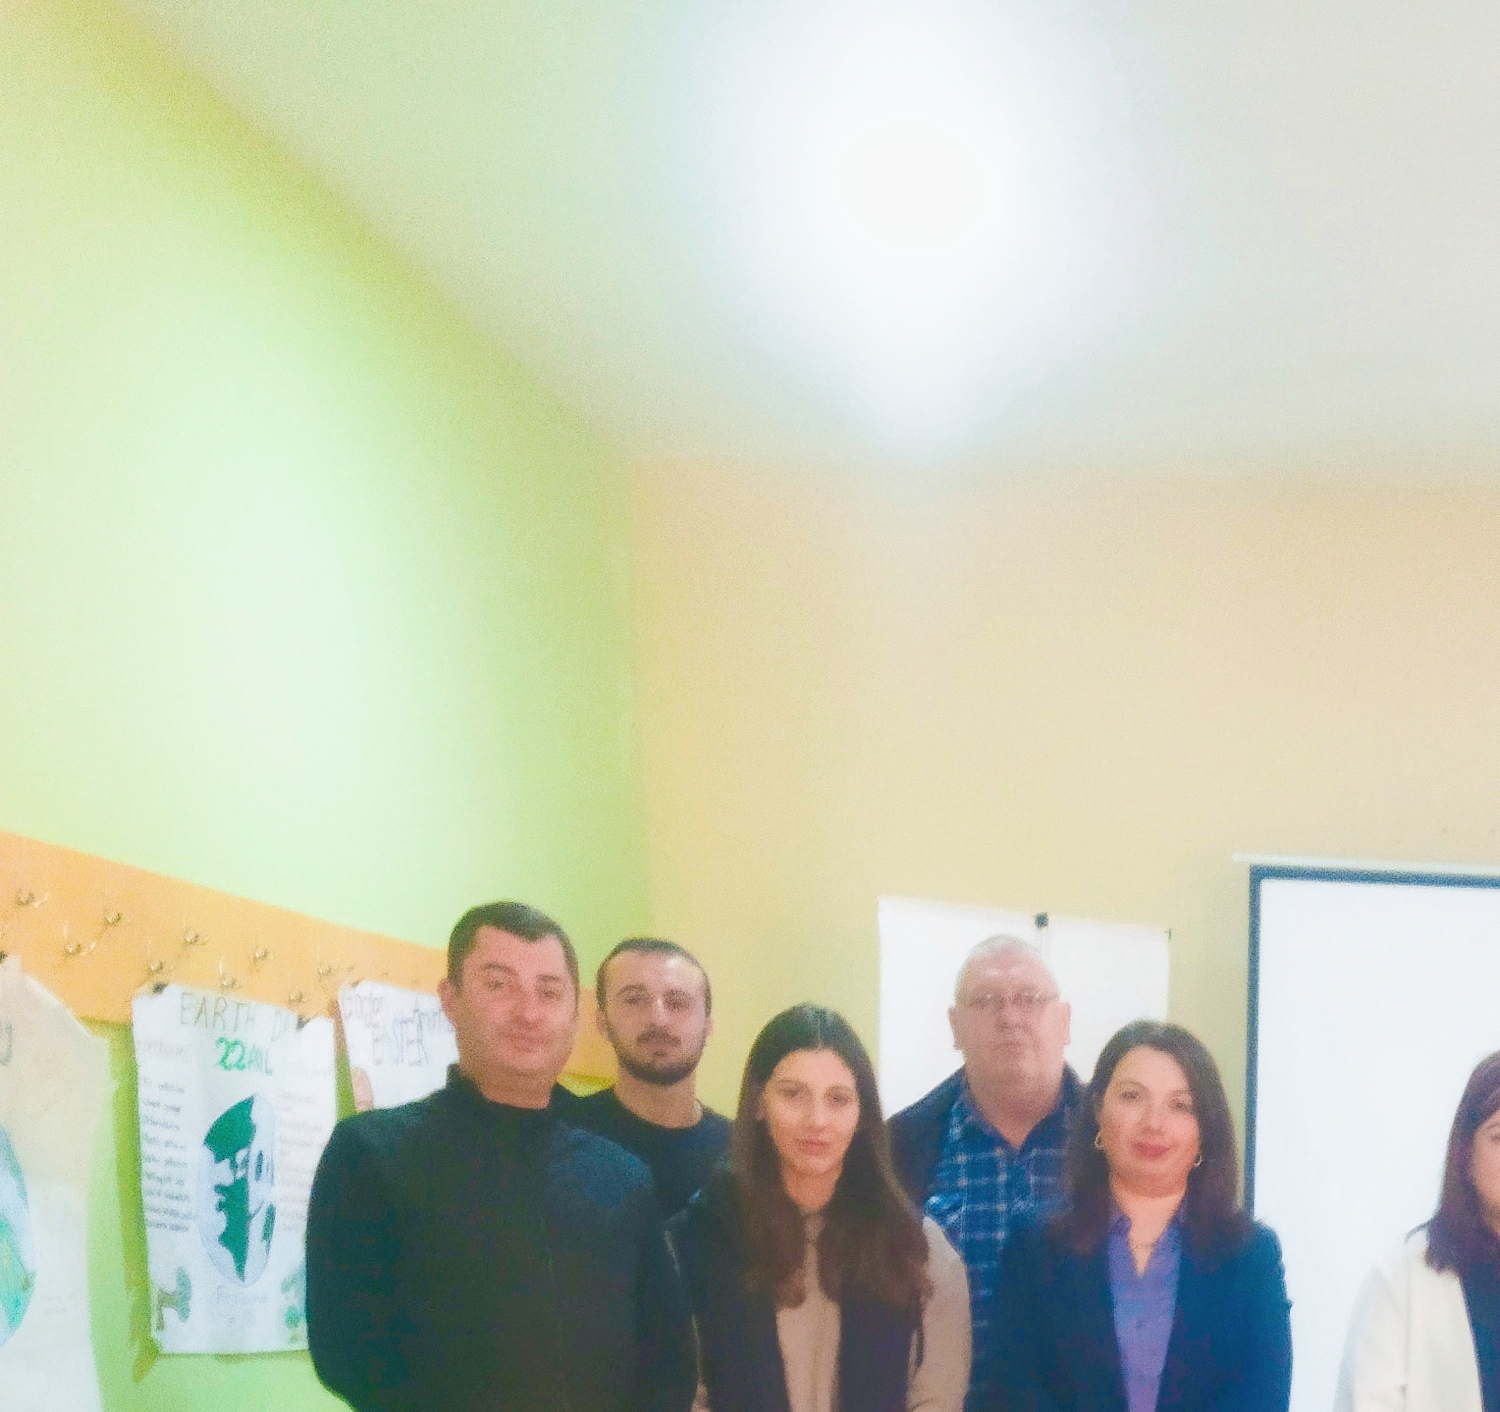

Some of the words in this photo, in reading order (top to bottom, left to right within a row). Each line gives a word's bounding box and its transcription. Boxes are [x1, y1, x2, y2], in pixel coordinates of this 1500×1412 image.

[180, 990, 256, 1032] EARTH
[214, 1036, 247, 1071] 22
[371, 1013, 429, 1066] ESTER
